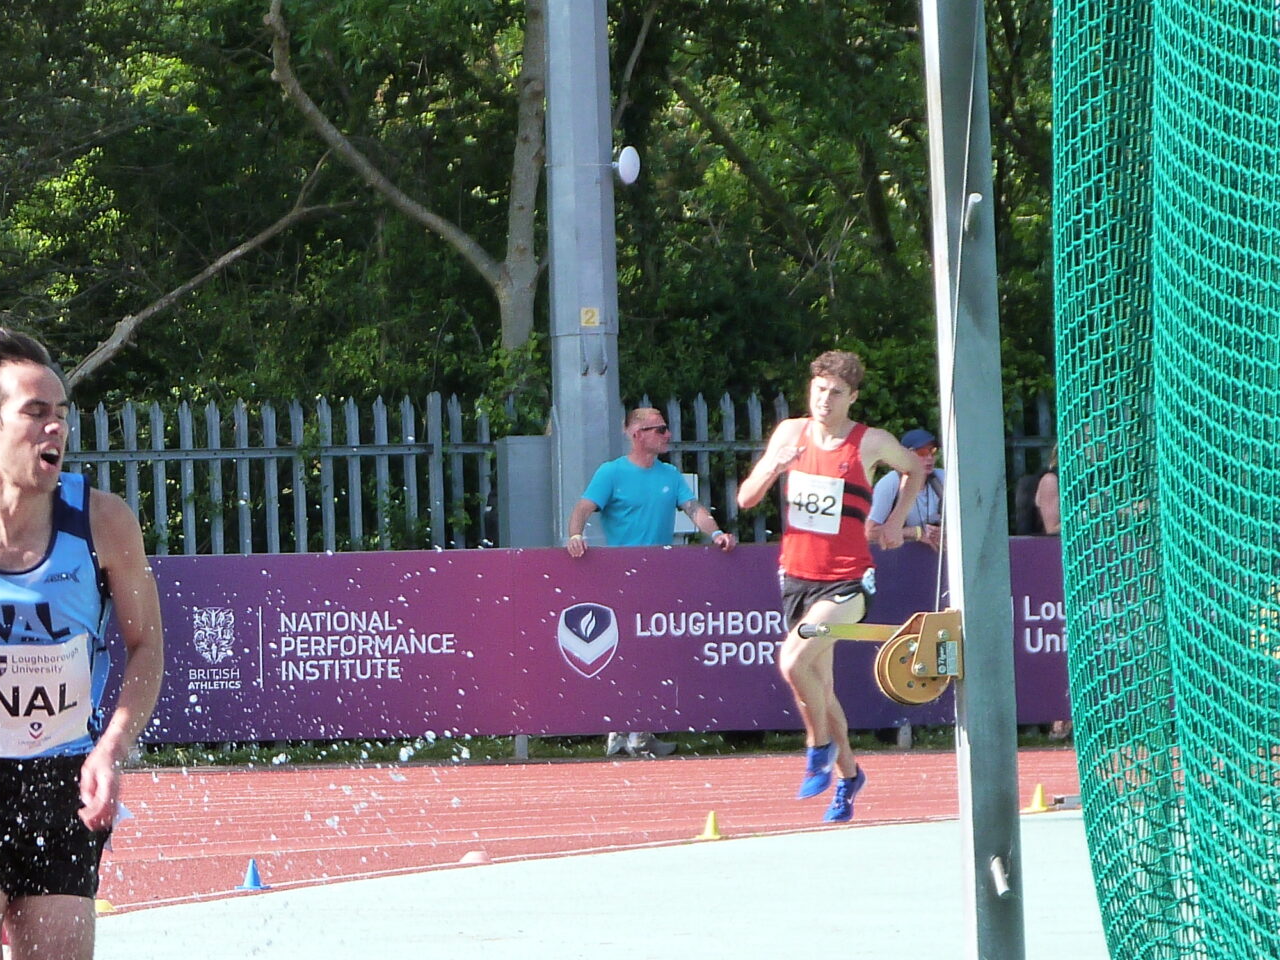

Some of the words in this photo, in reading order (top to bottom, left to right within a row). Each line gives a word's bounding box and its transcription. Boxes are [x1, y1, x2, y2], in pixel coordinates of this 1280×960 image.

[584, 309, 596, 325] 2
[793, 492, 836, 516] 482
[280, 611, 397, 632] NATIONAL
[636, 611, 789, 636] LOUGHBOR
[280, 634, 455, 657] PERFORMANCE
[11, 647, 79, 664] Loughborough
[11, 665, 64, 674] University
[189, 668, 240, 680] BRITISH
[281, 659, 401, 681] INSTITUTE
[188, 680, 241, 689] ATHLETICS
